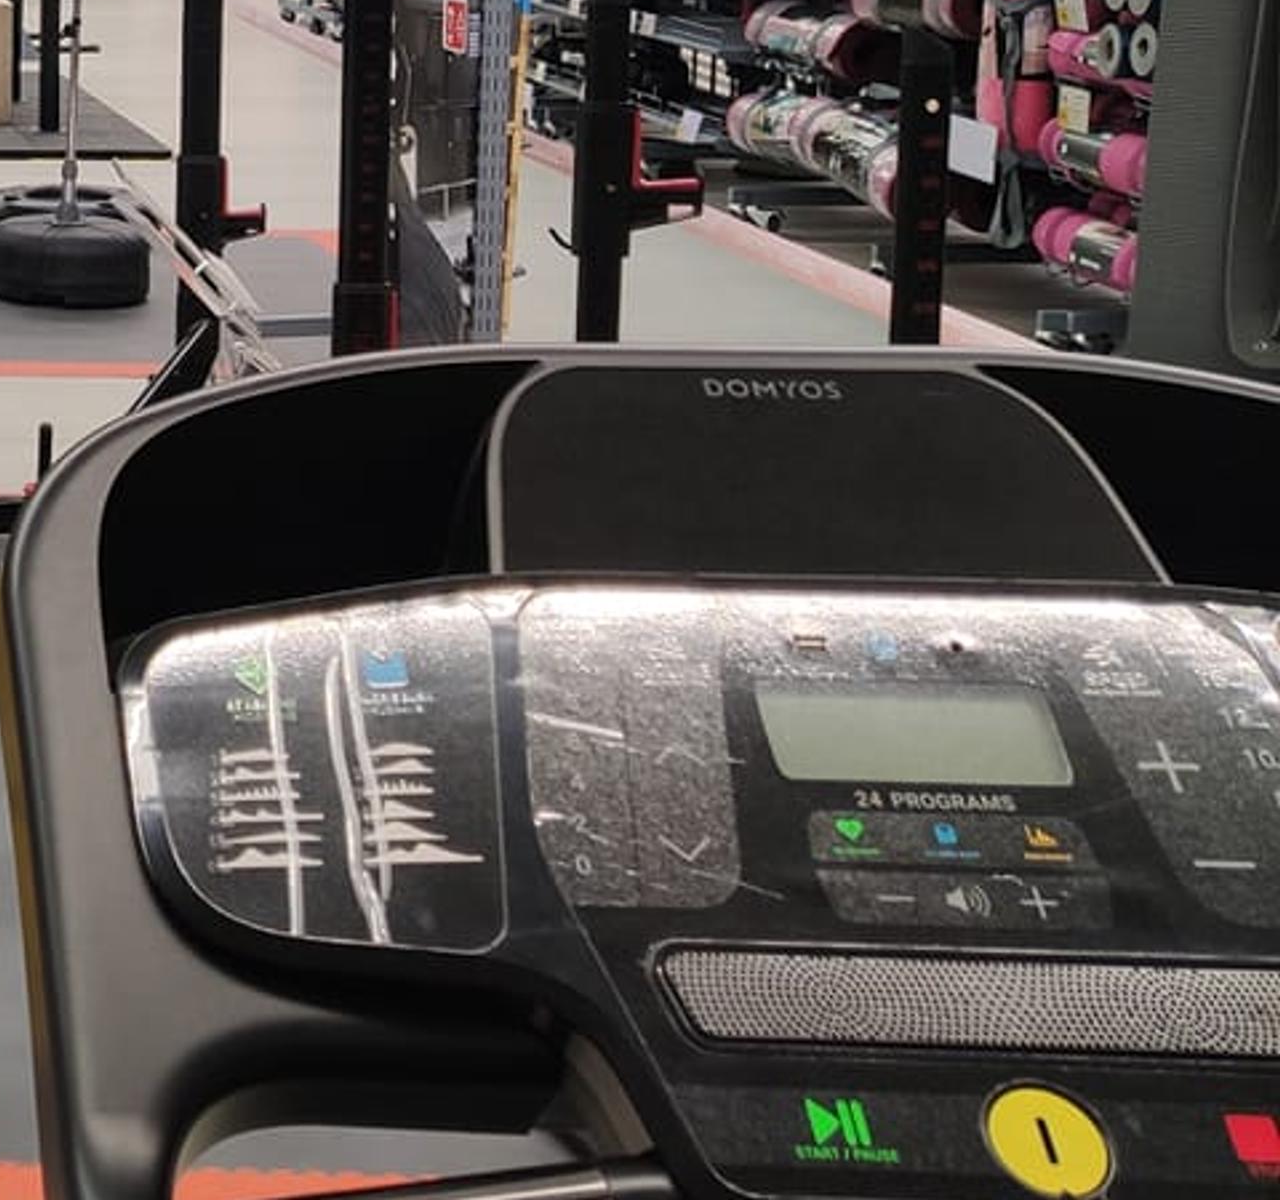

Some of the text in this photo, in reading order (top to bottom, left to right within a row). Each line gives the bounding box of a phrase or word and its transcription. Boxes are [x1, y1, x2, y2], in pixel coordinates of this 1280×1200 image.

[703, 377, 843, 400] DOMYOS
[853, 788, 1018, 813] 24 PROGRAMS
